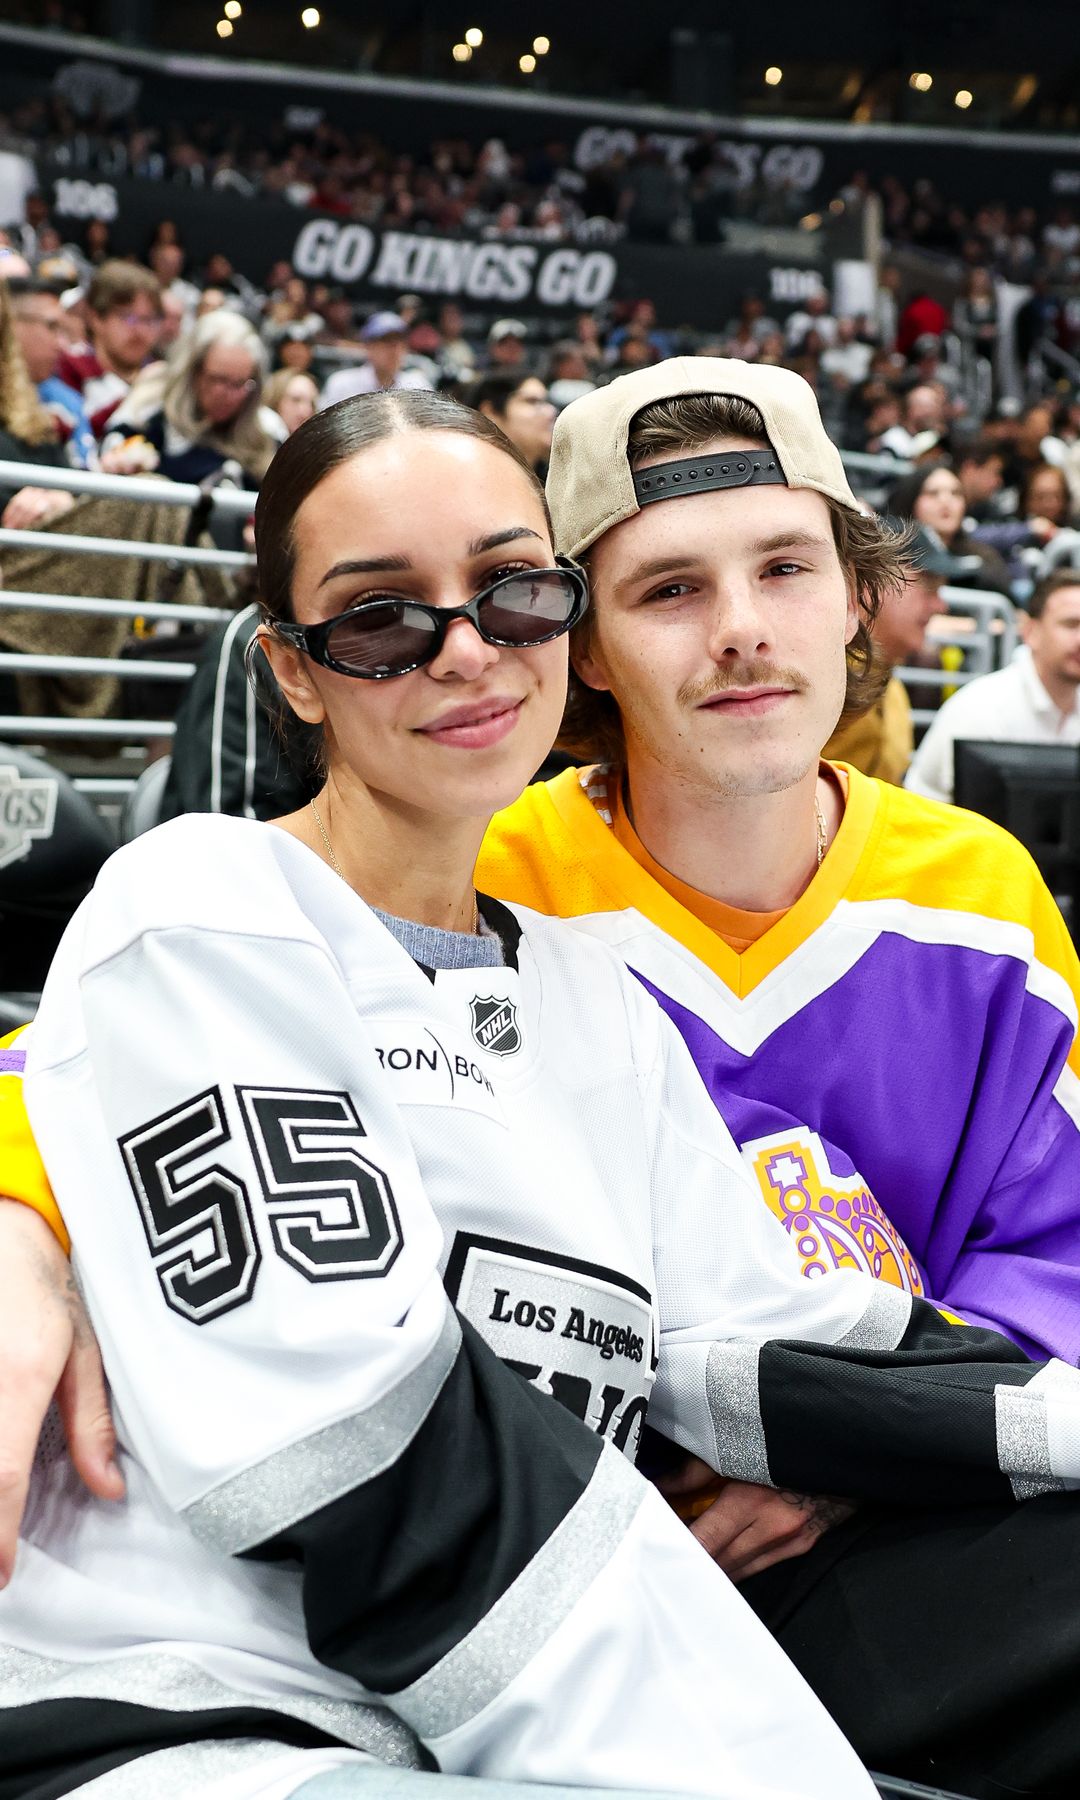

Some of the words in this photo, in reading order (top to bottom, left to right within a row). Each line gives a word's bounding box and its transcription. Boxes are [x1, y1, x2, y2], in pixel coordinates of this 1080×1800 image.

[293, 219, 374, 282] GO
[370, 230, 538, 299] KINGS
[536, 249, 617, 307] GO
[480, 1010, 511, 1046] NHL
[117, 1084, 404, 1326] 55
[489, 1288, 557, 1332] Los
[560, 1307, 644, 1363] Angeles
